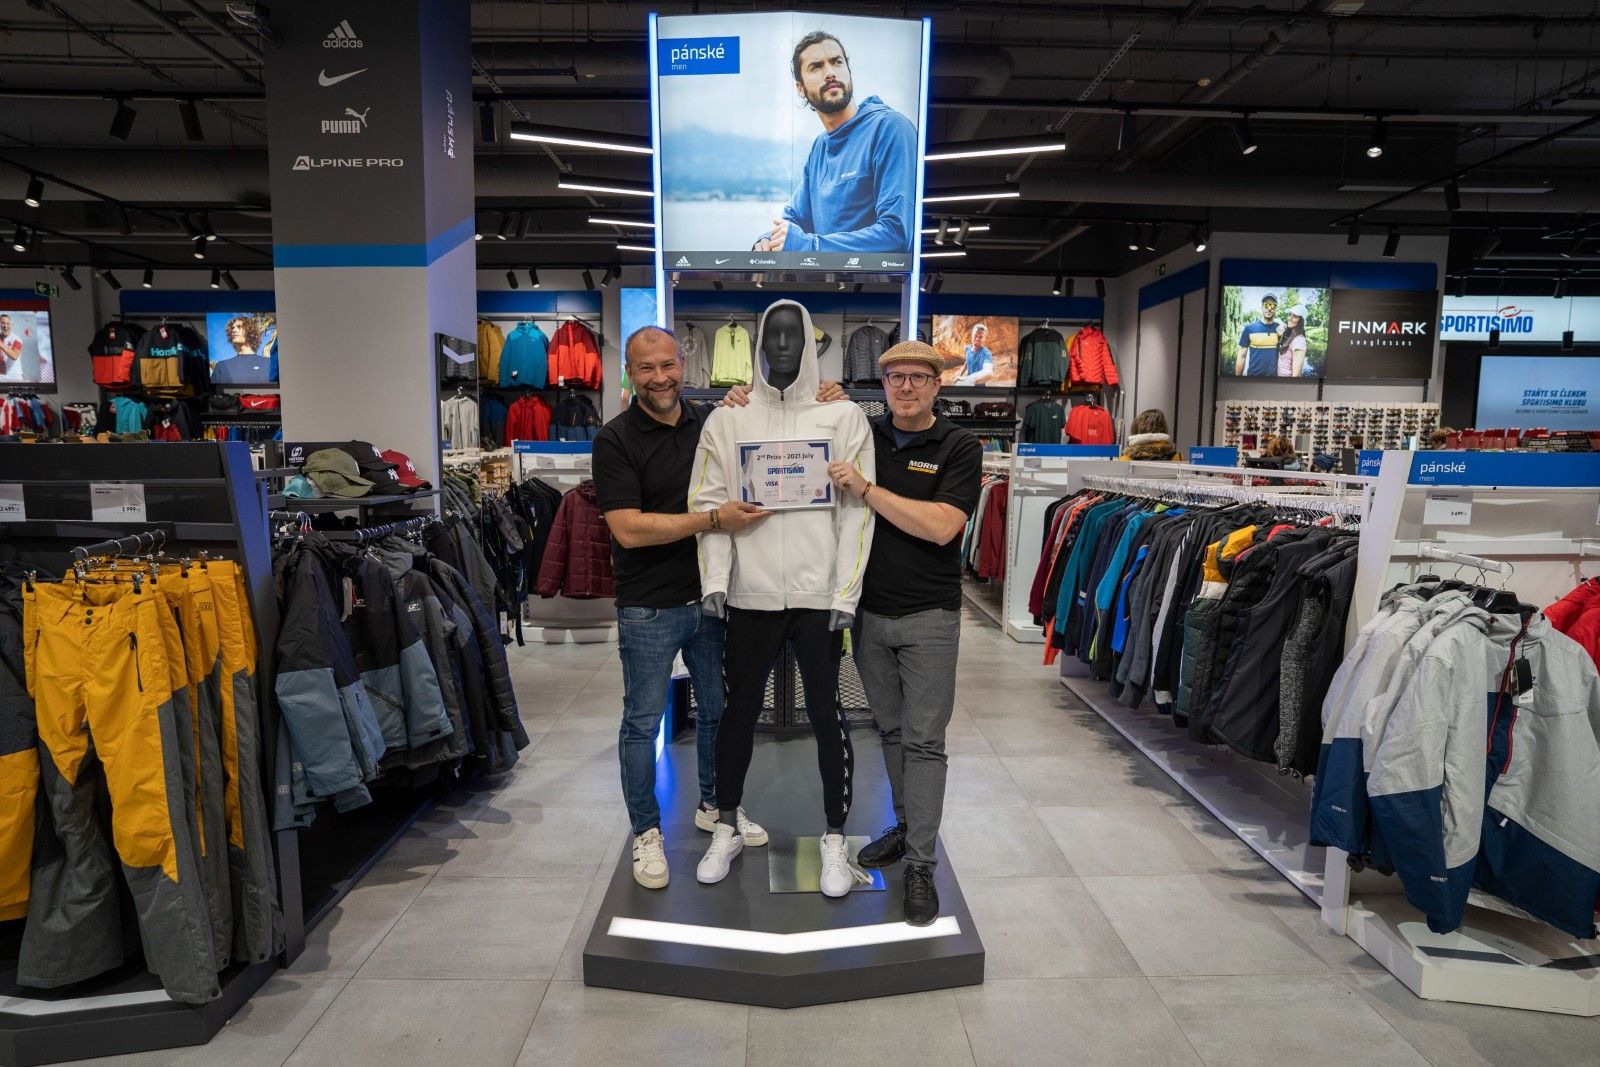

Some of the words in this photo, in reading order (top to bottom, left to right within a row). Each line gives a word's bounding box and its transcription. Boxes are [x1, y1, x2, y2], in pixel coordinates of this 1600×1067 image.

[322, 38, 364, 48] adidas
[671, 43, 725, 63] pánské
[321, 120, 361, 134] PUMA
[292, 155, 363, 170] ALPINE
[366, 158, 404, 167] PRO
[1338, 321, 1427, 334] FINMARK
[909, 460, 938, 470] MORIS
[1361, 458, 1381, 468] pánsk
[1420, 461, 1466, 474] pánské
[767, 467, 804, 475] SPORTISIMO
